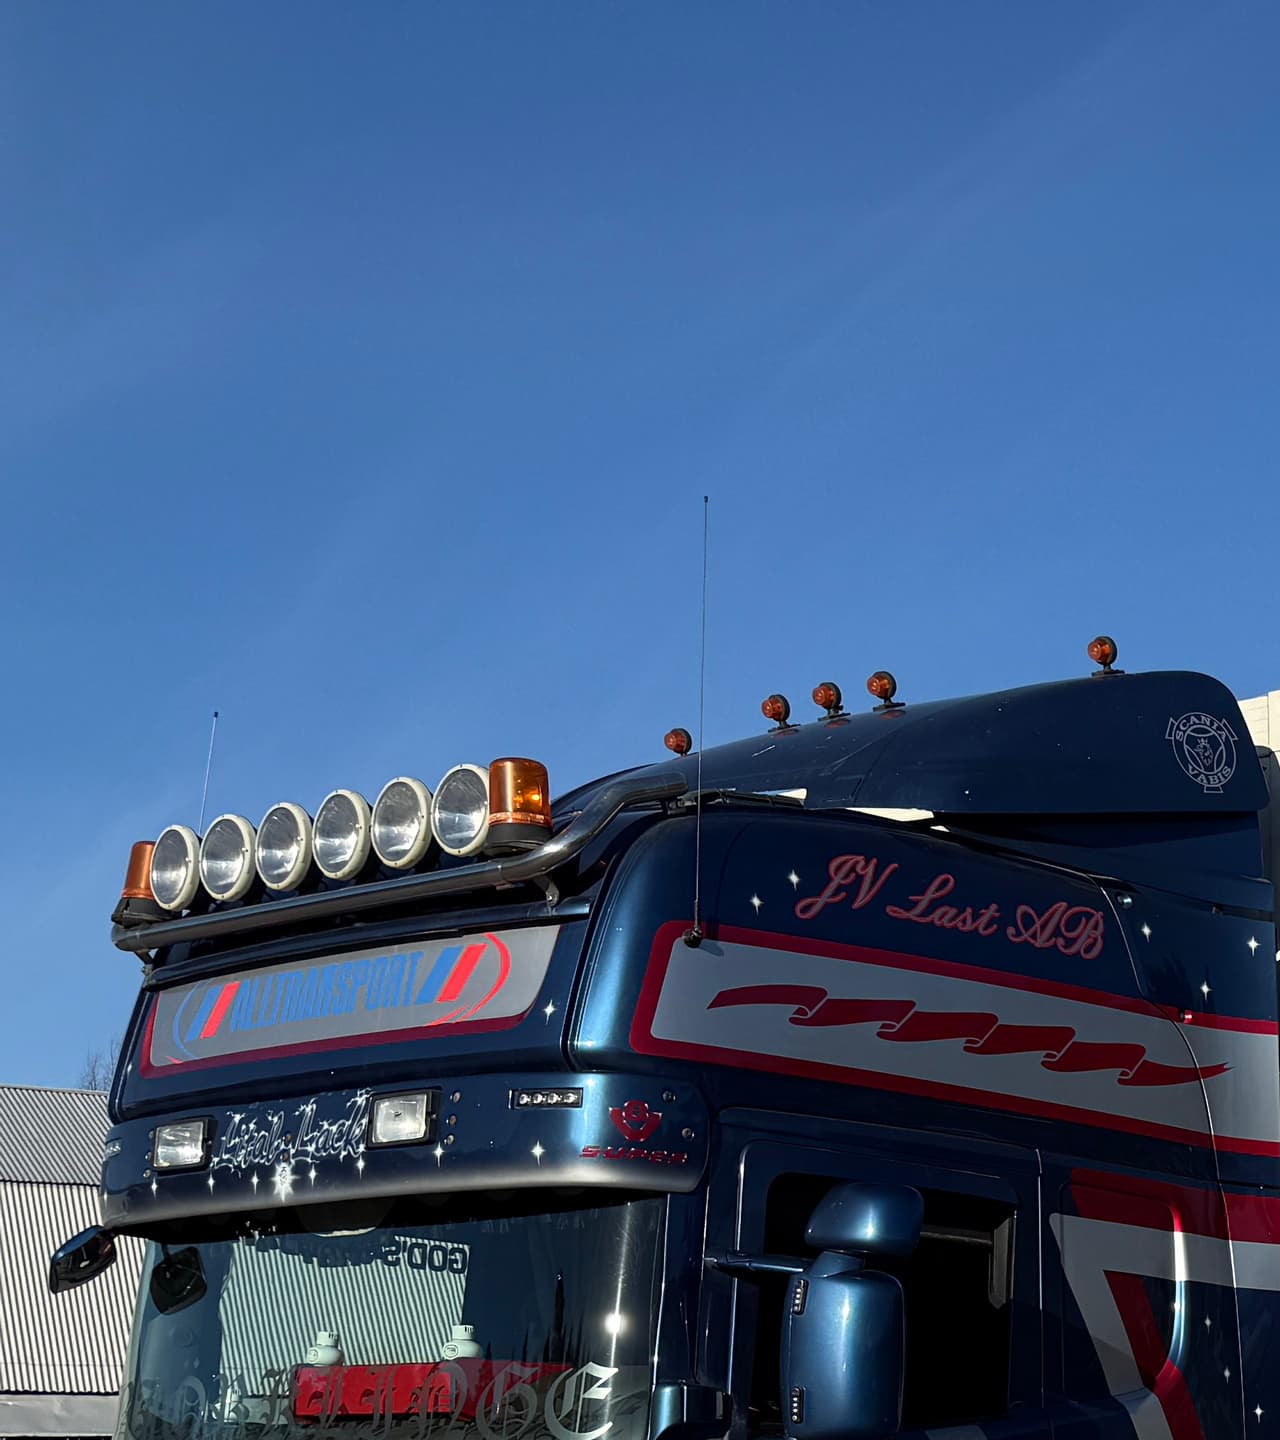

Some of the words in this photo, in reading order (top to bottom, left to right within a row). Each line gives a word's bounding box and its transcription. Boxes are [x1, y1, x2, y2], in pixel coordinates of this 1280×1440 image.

[1175, 715, 1226, 742] SCANIA
[1187, 763, 1231, 785] VABIS
[886, 873, 1001, 936] Last
[1006, 901, 1105, 960] AB
[230, 950, 426, 1033] ALLTRANSPORT
